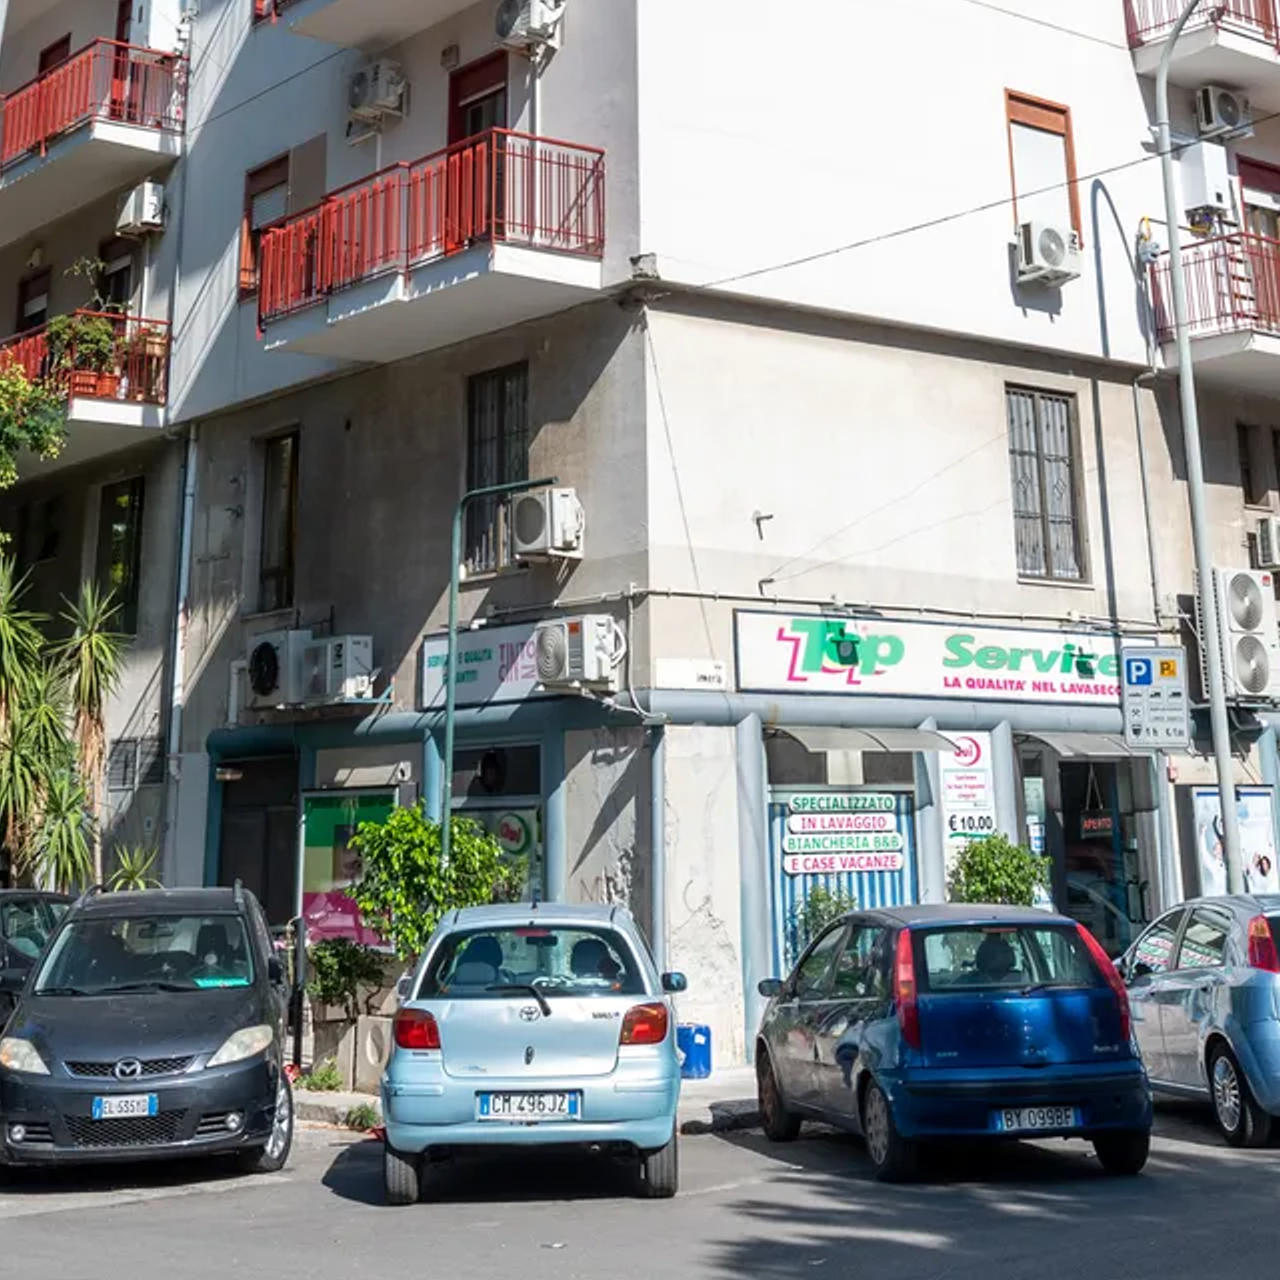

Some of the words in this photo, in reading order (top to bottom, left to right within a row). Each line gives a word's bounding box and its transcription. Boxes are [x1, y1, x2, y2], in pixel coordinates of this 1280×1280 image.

[498, 640, 536, 663] TINTO
[777, 618, 905, 684] Top
[1129, 661, 1148, 684] P
[943, 676, 962, 688] LA
[966, 677, 1026, 691] QUALITA'
[1032, 681, 1056, 693] NEL
[791, 796, 894, 810] SPECIALIZZATO
[801, 817, 817, 830] IN
[820, 815, 888, 830] LAVAGGIO
[948, 814, 957, 831] €
[960, 815, 993, 832] 10,00
[787, 835, 870, 851] BIANCHERIA
[873, 835, 900, 849] B&B
[791, 858, 800, 872] E
[802, 856, 836, 871] CASE
[839, 854, 898, 870] VACANZE
[516, 1093, 567, 1113] 496JZ
[1004, 1109, 1022, 1128] BY
